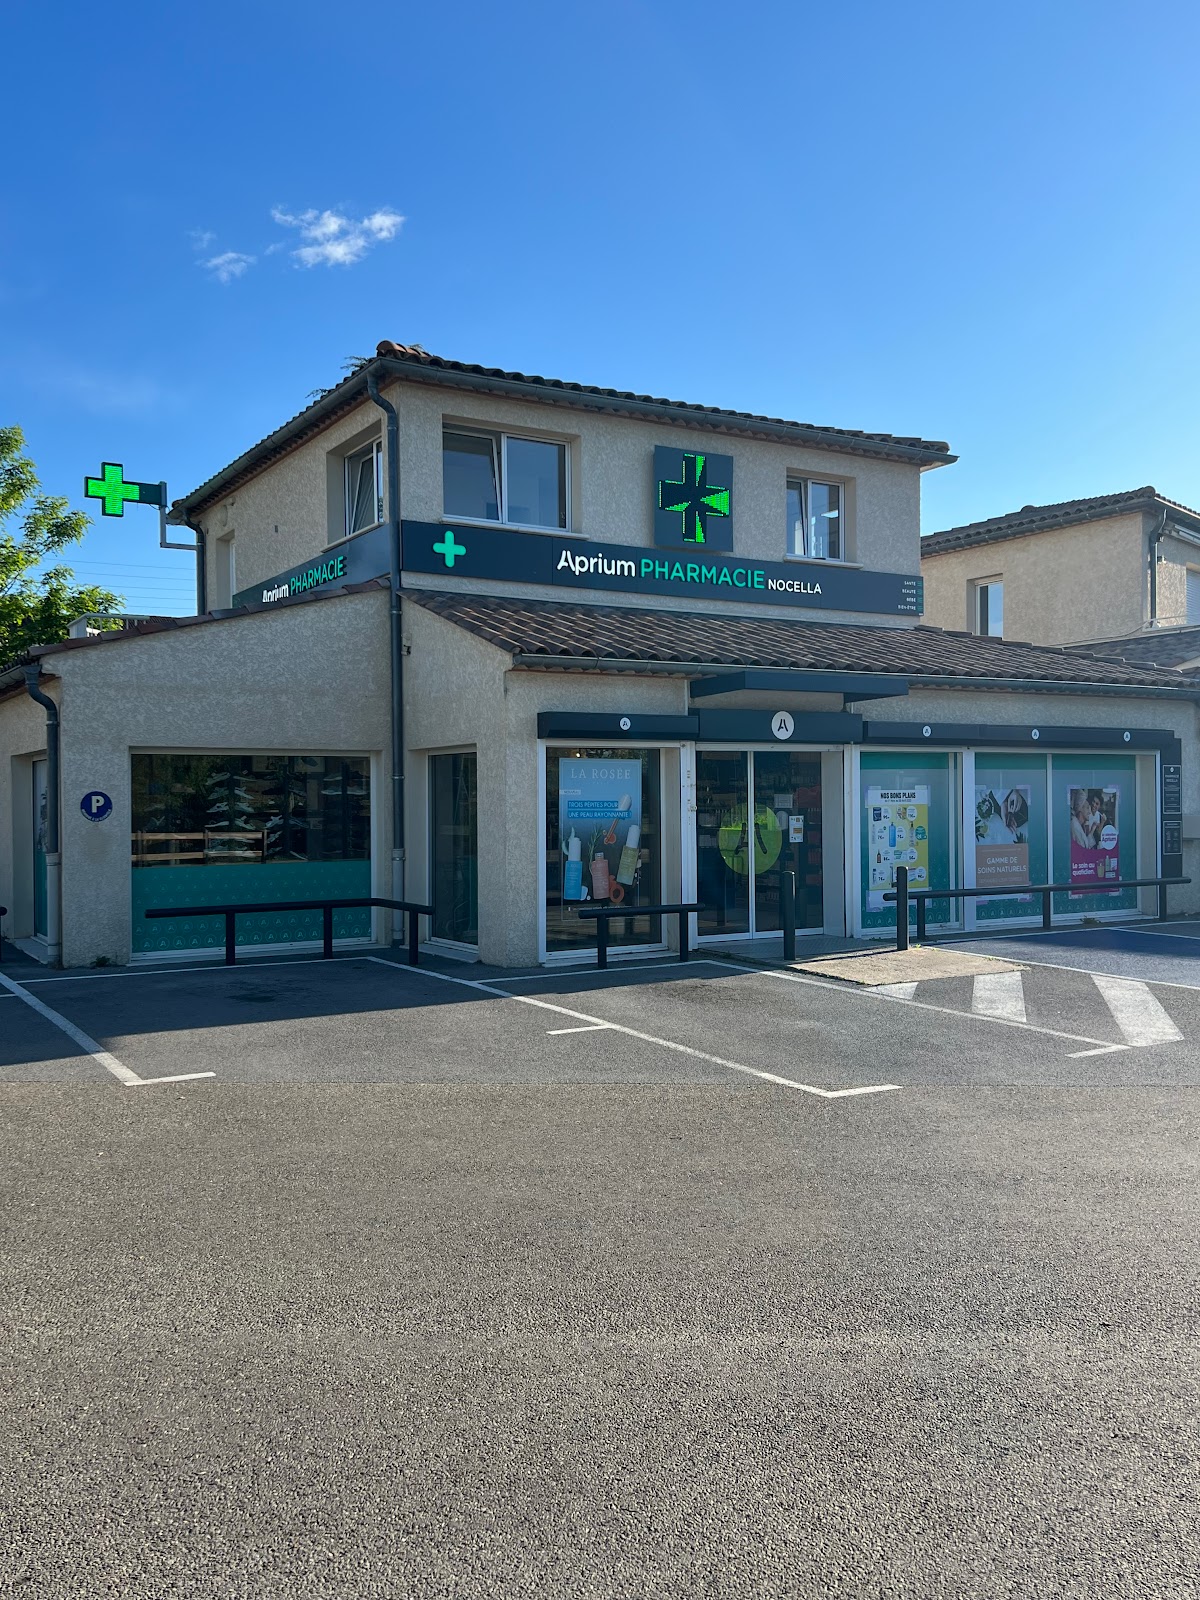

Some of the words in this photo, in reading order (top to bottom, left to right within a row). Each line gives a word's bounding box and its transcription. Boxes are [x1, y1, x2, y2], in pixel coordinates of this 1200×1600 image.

[290, 556, 344, 596] PHARMACIE
[557, 550, 635, 576] Aprium
[640, 558, 765, 589] PHARMACIE
[767, 578, 822, 595] NOCELLA
[570, 768, 587, 779] LA
[592, 767, 631, 780] ROSÉE
[91, 796, 105, 813] P
[977, 866, 996, 874] SOINS
[996, 864, 1027, 873] NATURELS
